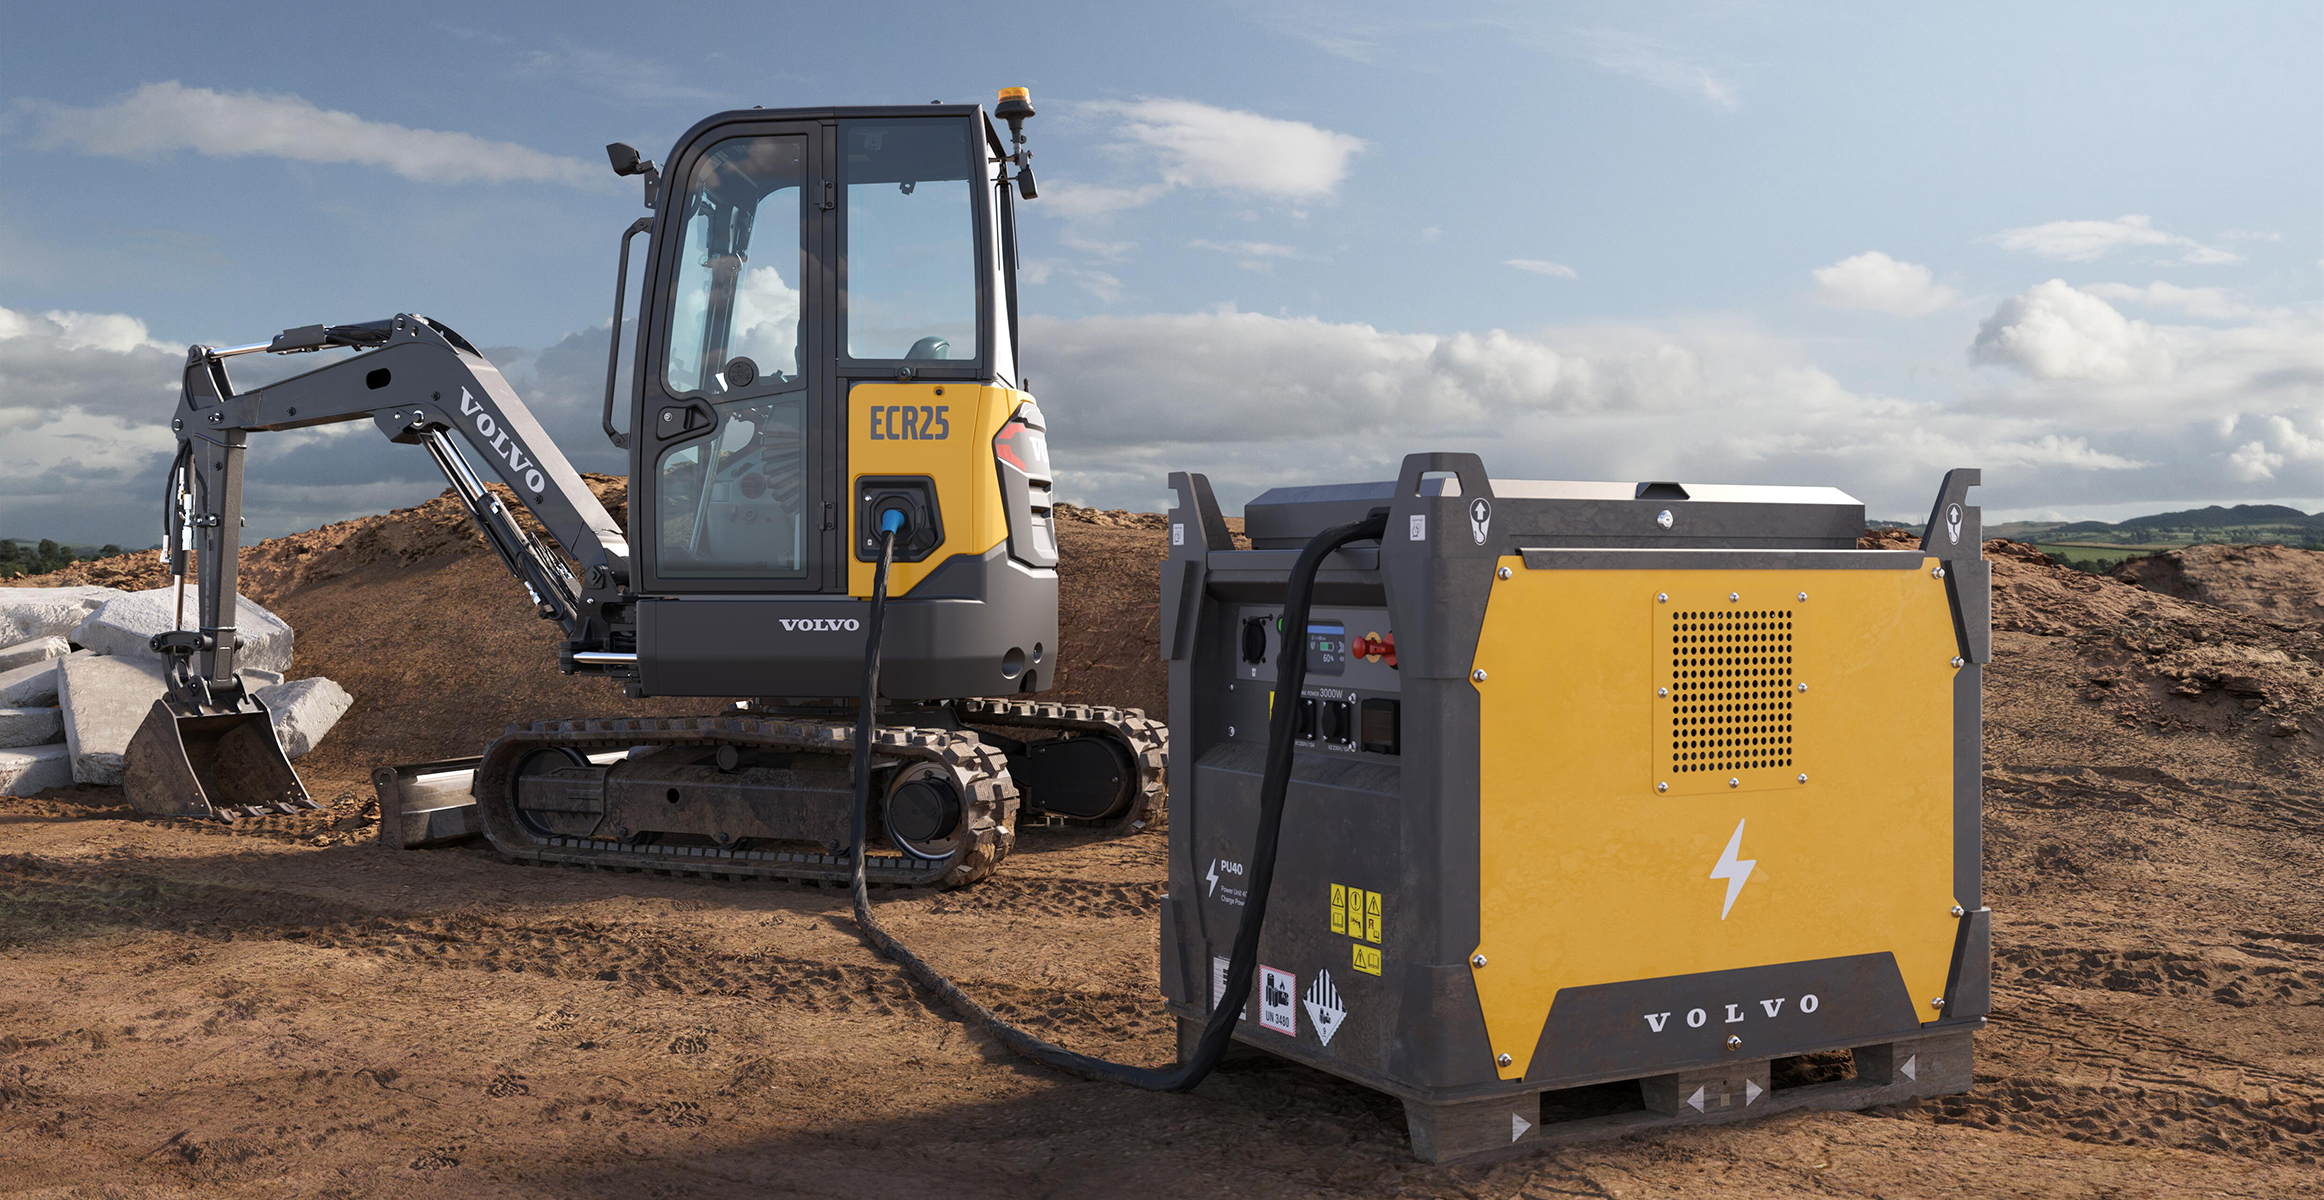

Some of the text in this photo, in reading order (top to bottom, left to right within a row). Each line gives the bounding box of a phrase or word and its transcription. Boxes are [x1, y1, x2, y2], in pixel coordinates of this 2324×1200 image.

[870, 405, 949, 440] ECR25
[460, 385, 545, 493] VOLVO
[779, 619, 860, 631] VOLVO
[1320, 688, 1343, 699] 3000W
[1221, 859, 1243, 875] PU40
[1221, 885, 1234, 894] Power
[1266, 1010, 1290, 1027] UN 3480
[1644, 994, 1819, 1033] VOLVO
